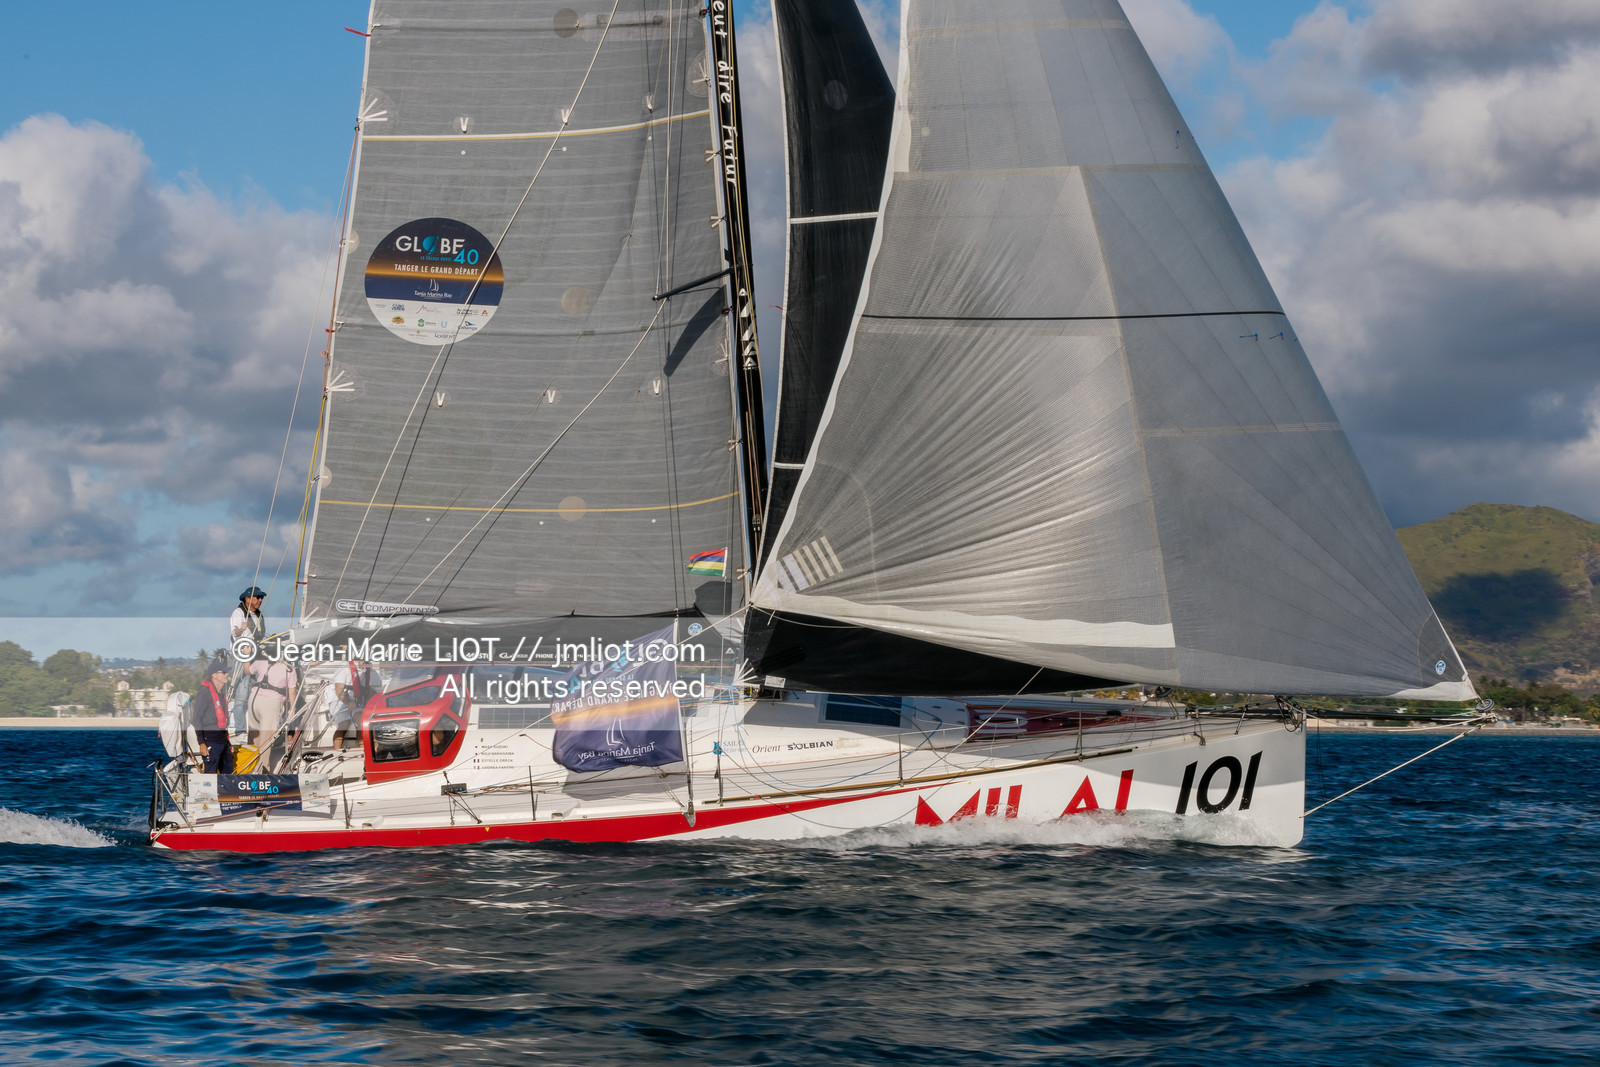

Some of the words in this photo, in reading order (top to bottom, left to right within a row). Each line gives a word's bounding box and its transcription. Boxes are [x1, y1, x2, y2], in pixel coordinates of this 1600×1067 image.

[395, 235, 465, 255] GLOBE
[453, 248, 480, 265] 40
[394, 263, 419, 272] TANGER
[421, 265, 430, 273] LE
[430, 266, 453, 275] GRAND
[454, 266, 479, 276] DÉPART
[752, 744, 781, 754] Orient
[238, 780, 271, 791] GLOBE
[266, 785, 279, 794] 40
[1175, 751, 1263, 815] 101
